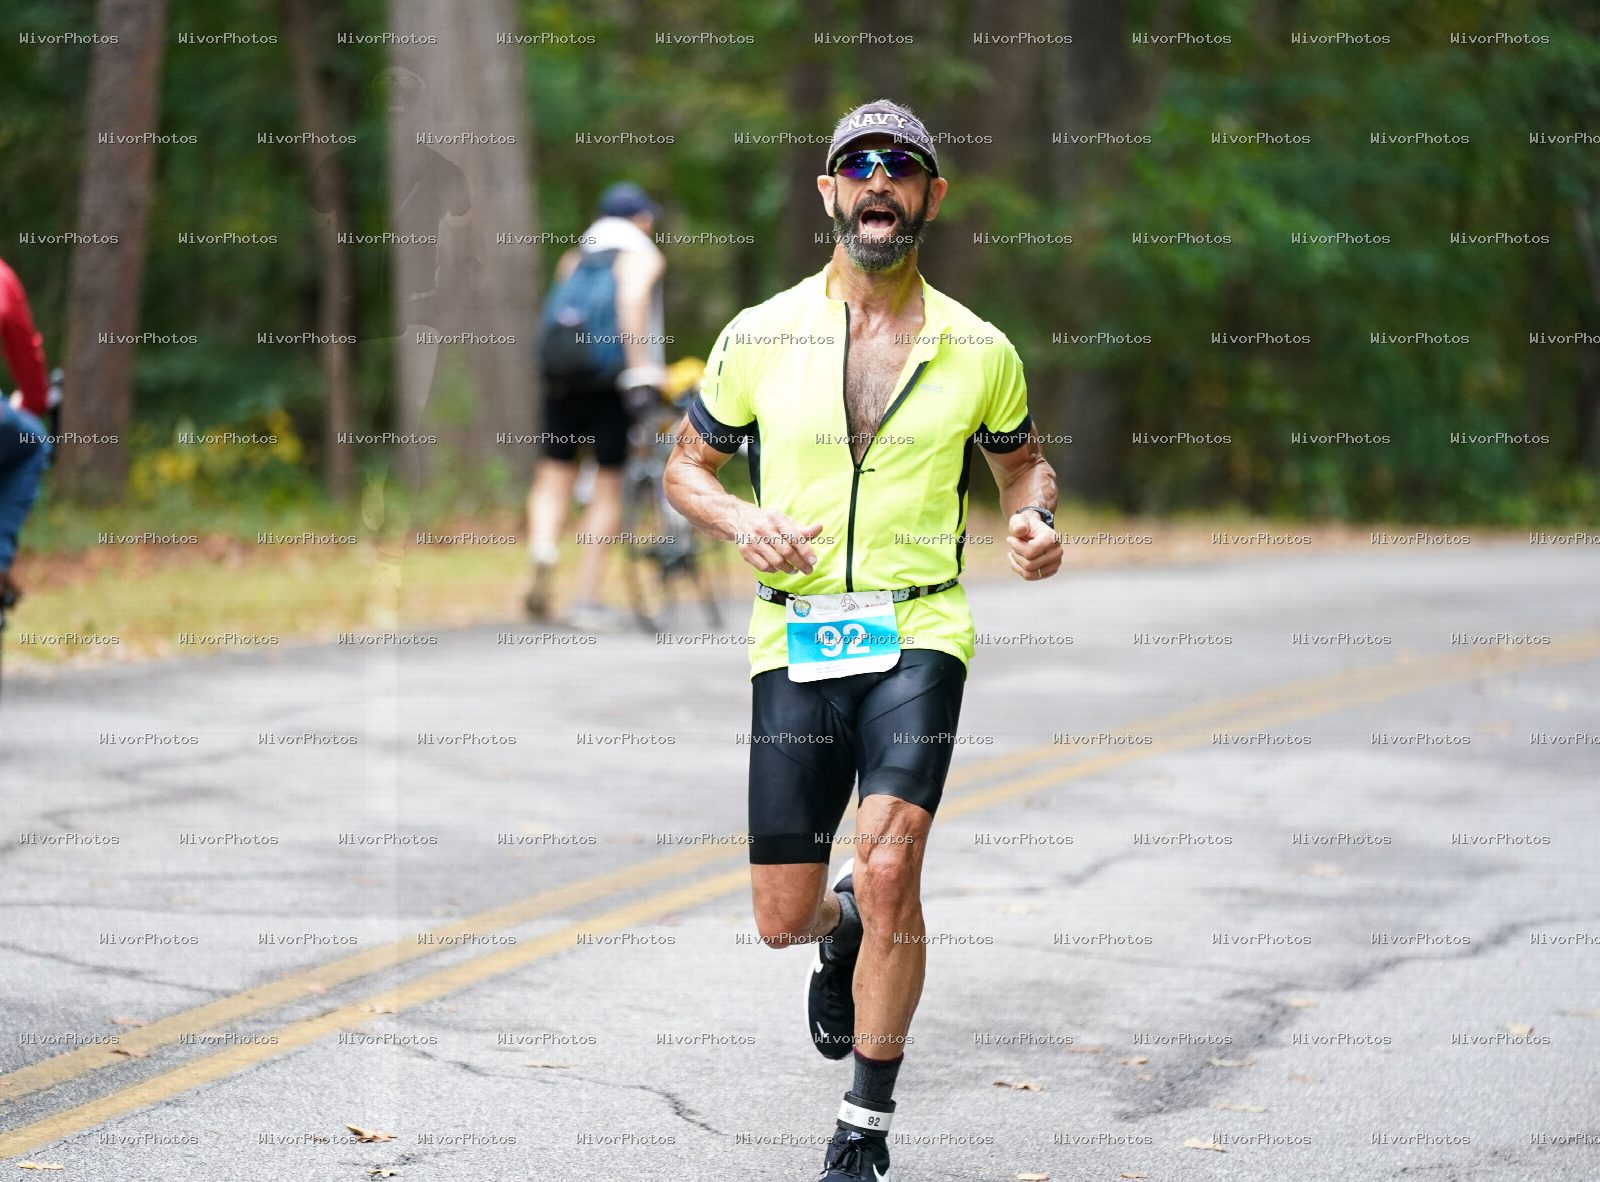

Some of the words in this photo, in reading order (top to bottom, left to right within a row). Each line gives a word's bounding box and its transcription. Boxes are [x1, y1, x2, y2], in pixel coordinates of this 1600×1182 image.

[847, 113, 908, 131] NAVY
[817, 623, 870, 658] 92
[867, 1116, 881, 1127] 92
